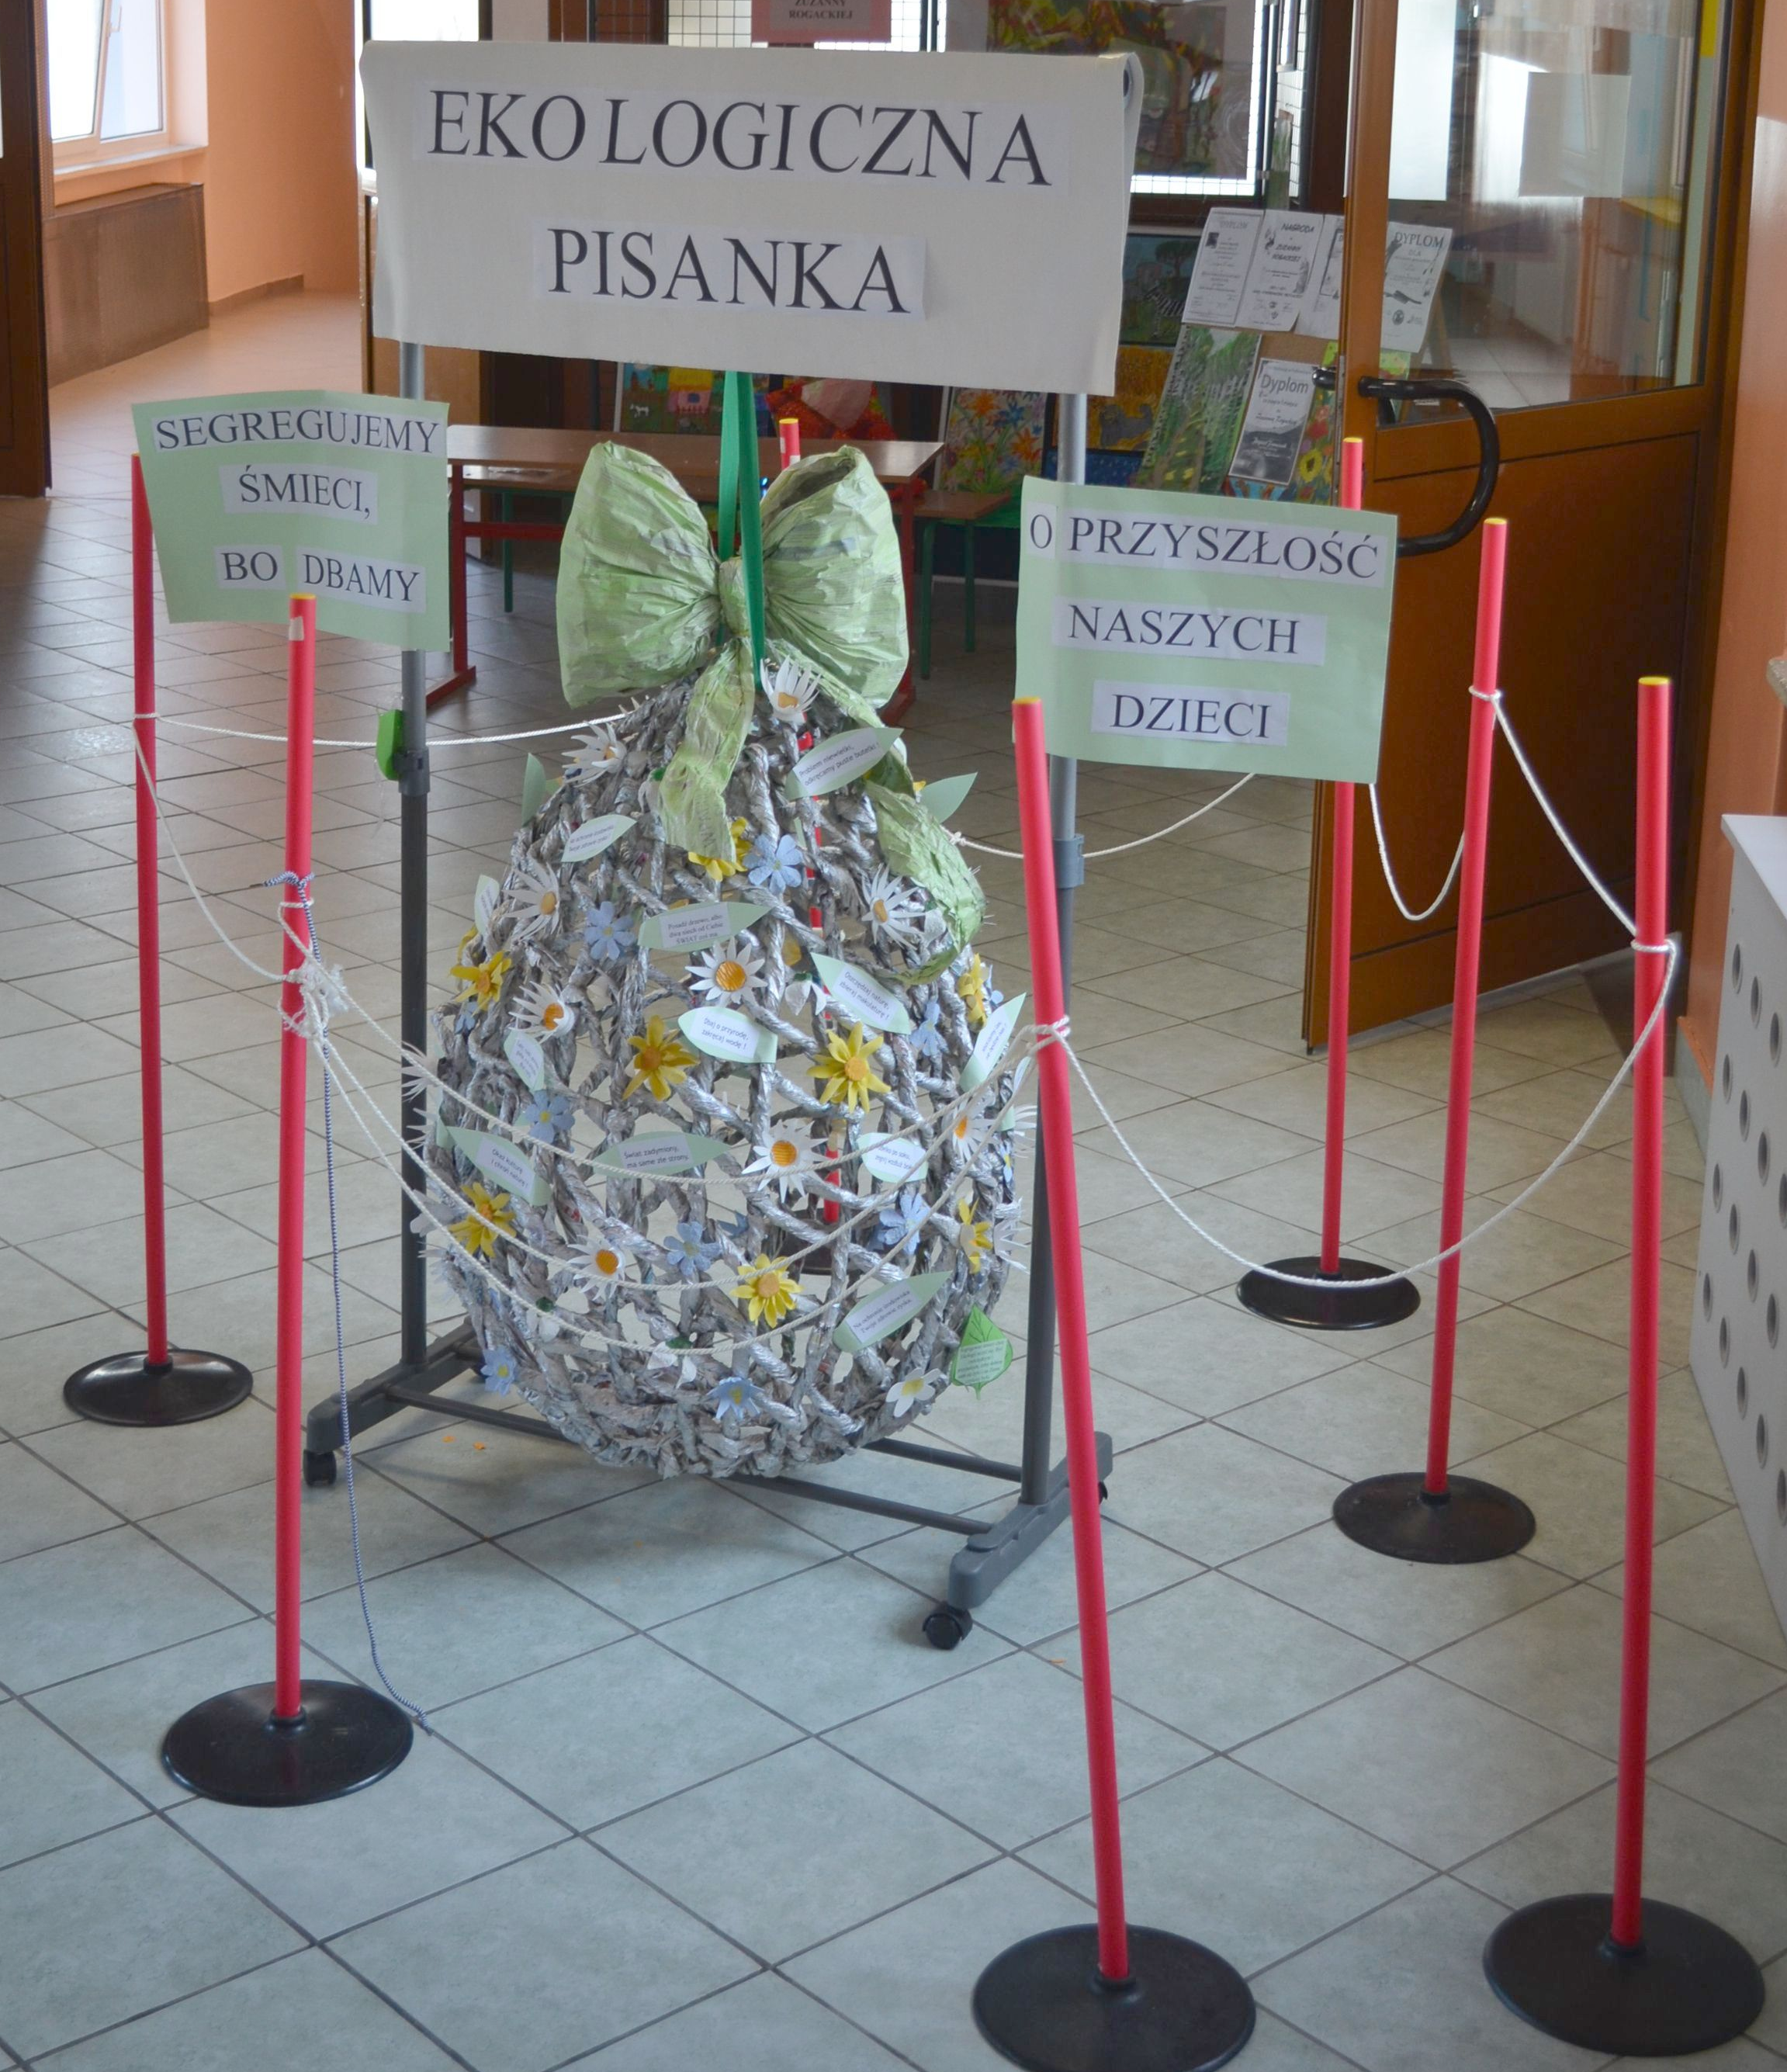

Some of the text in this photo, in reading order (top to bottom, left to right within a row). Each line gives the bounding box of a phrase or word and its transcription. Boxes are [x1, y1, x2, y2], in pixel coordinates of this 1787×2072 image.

[788, 10, 853, 19] ROGACKIEJ
[427, 89, 1052, 186] EKOLOGICZNA
[1281, 223, 1315, 234] NAGRODA
[1394, 232, 1445, 248] DYPLOM
[546, 228, 911, 314] PISANKA
[1260, 374, 1309, 393] Dyplom
[156, 409, 440, 454] SEGREGUJEMY
[239, 465, 371, 519] ŚMIECI,
[1030, 515, 1379, 579] O PRZYSZŁOŚĆ
[221, 552, 421, 602] BO DBAMY
[1068, 605, 1300, 655] NASZYCH
[1110, 694, 1273, 738] DZIECI
[835, 754, 854, 768] puste
[623, 1149, 641, 1159] Świat
